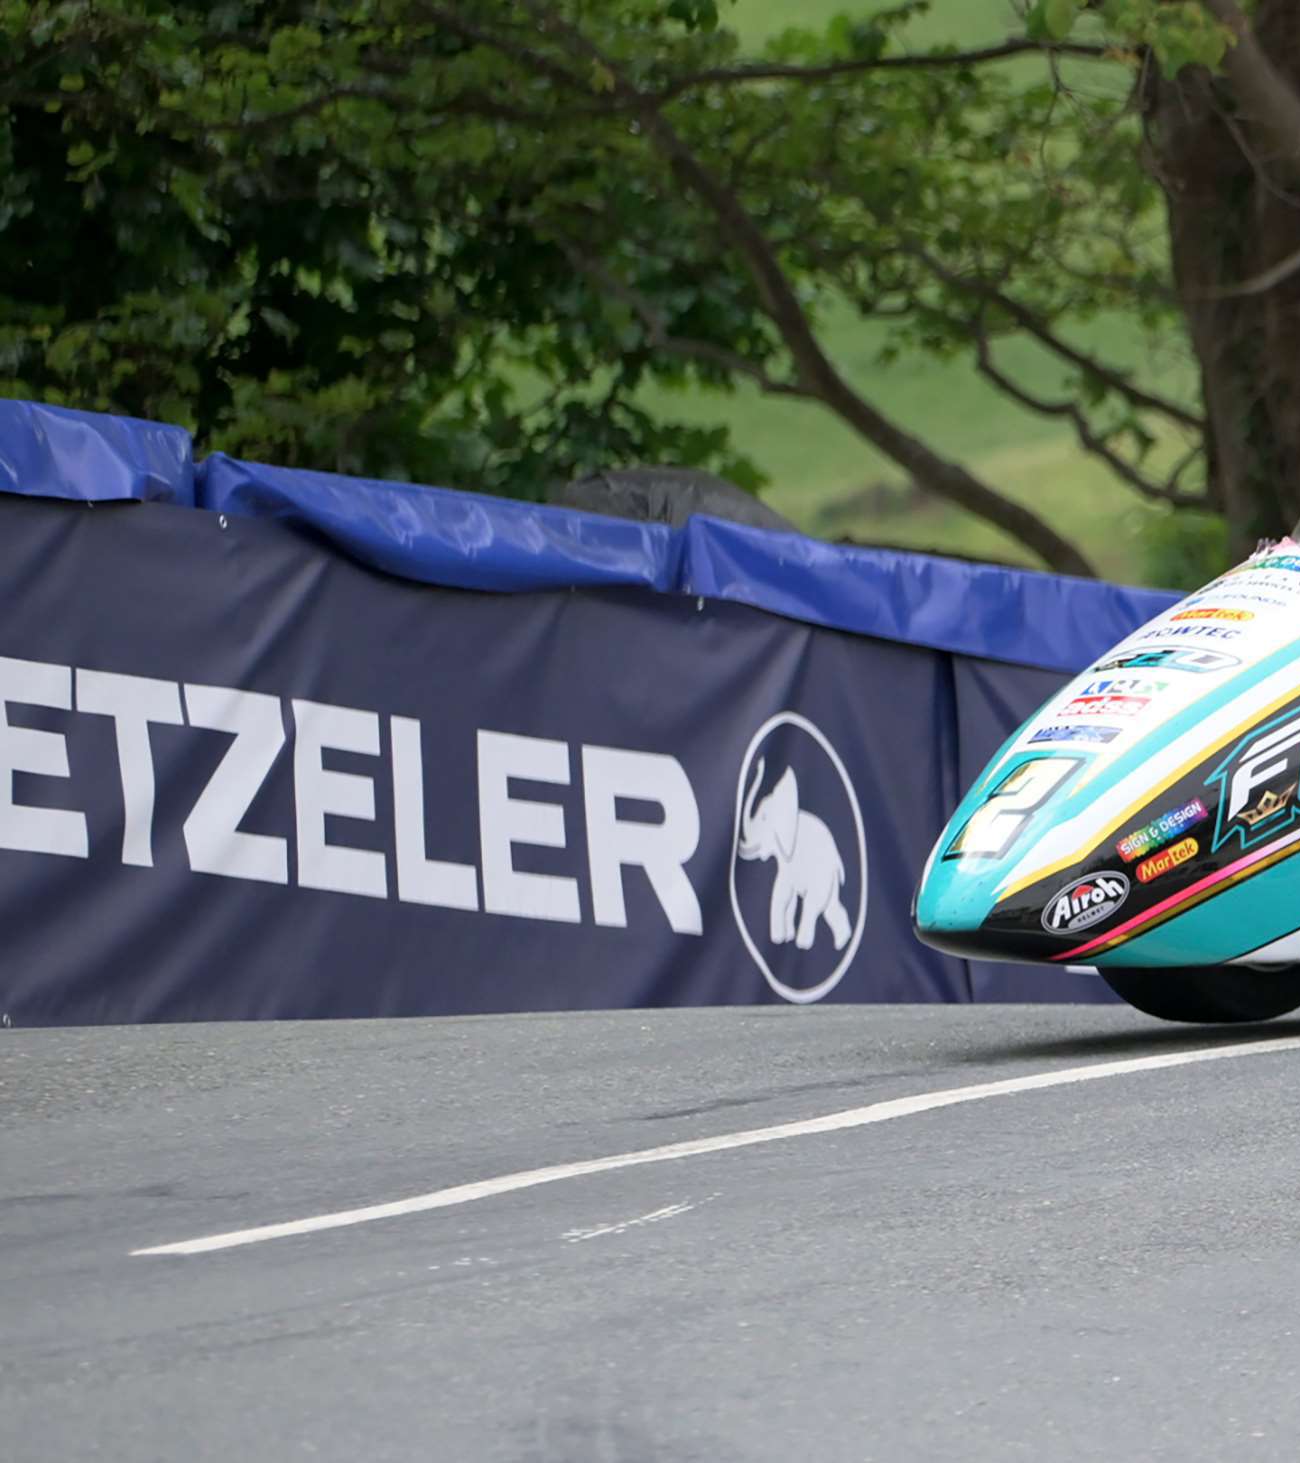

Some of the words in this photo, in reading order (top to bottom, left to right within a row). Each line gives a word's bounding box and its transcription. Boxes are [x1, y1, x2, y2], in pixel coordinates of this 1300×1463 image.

[0, 656, 703, 935] ETZELER
[943, 757, 1086, 862] 2
[1120, 834, 1149, 855] SIGN
[1159, 801, 1202, 832] DESIGN
[1141, 840, 1195, 881] Martek
[1052, 877, 1125, 929] Airoh
